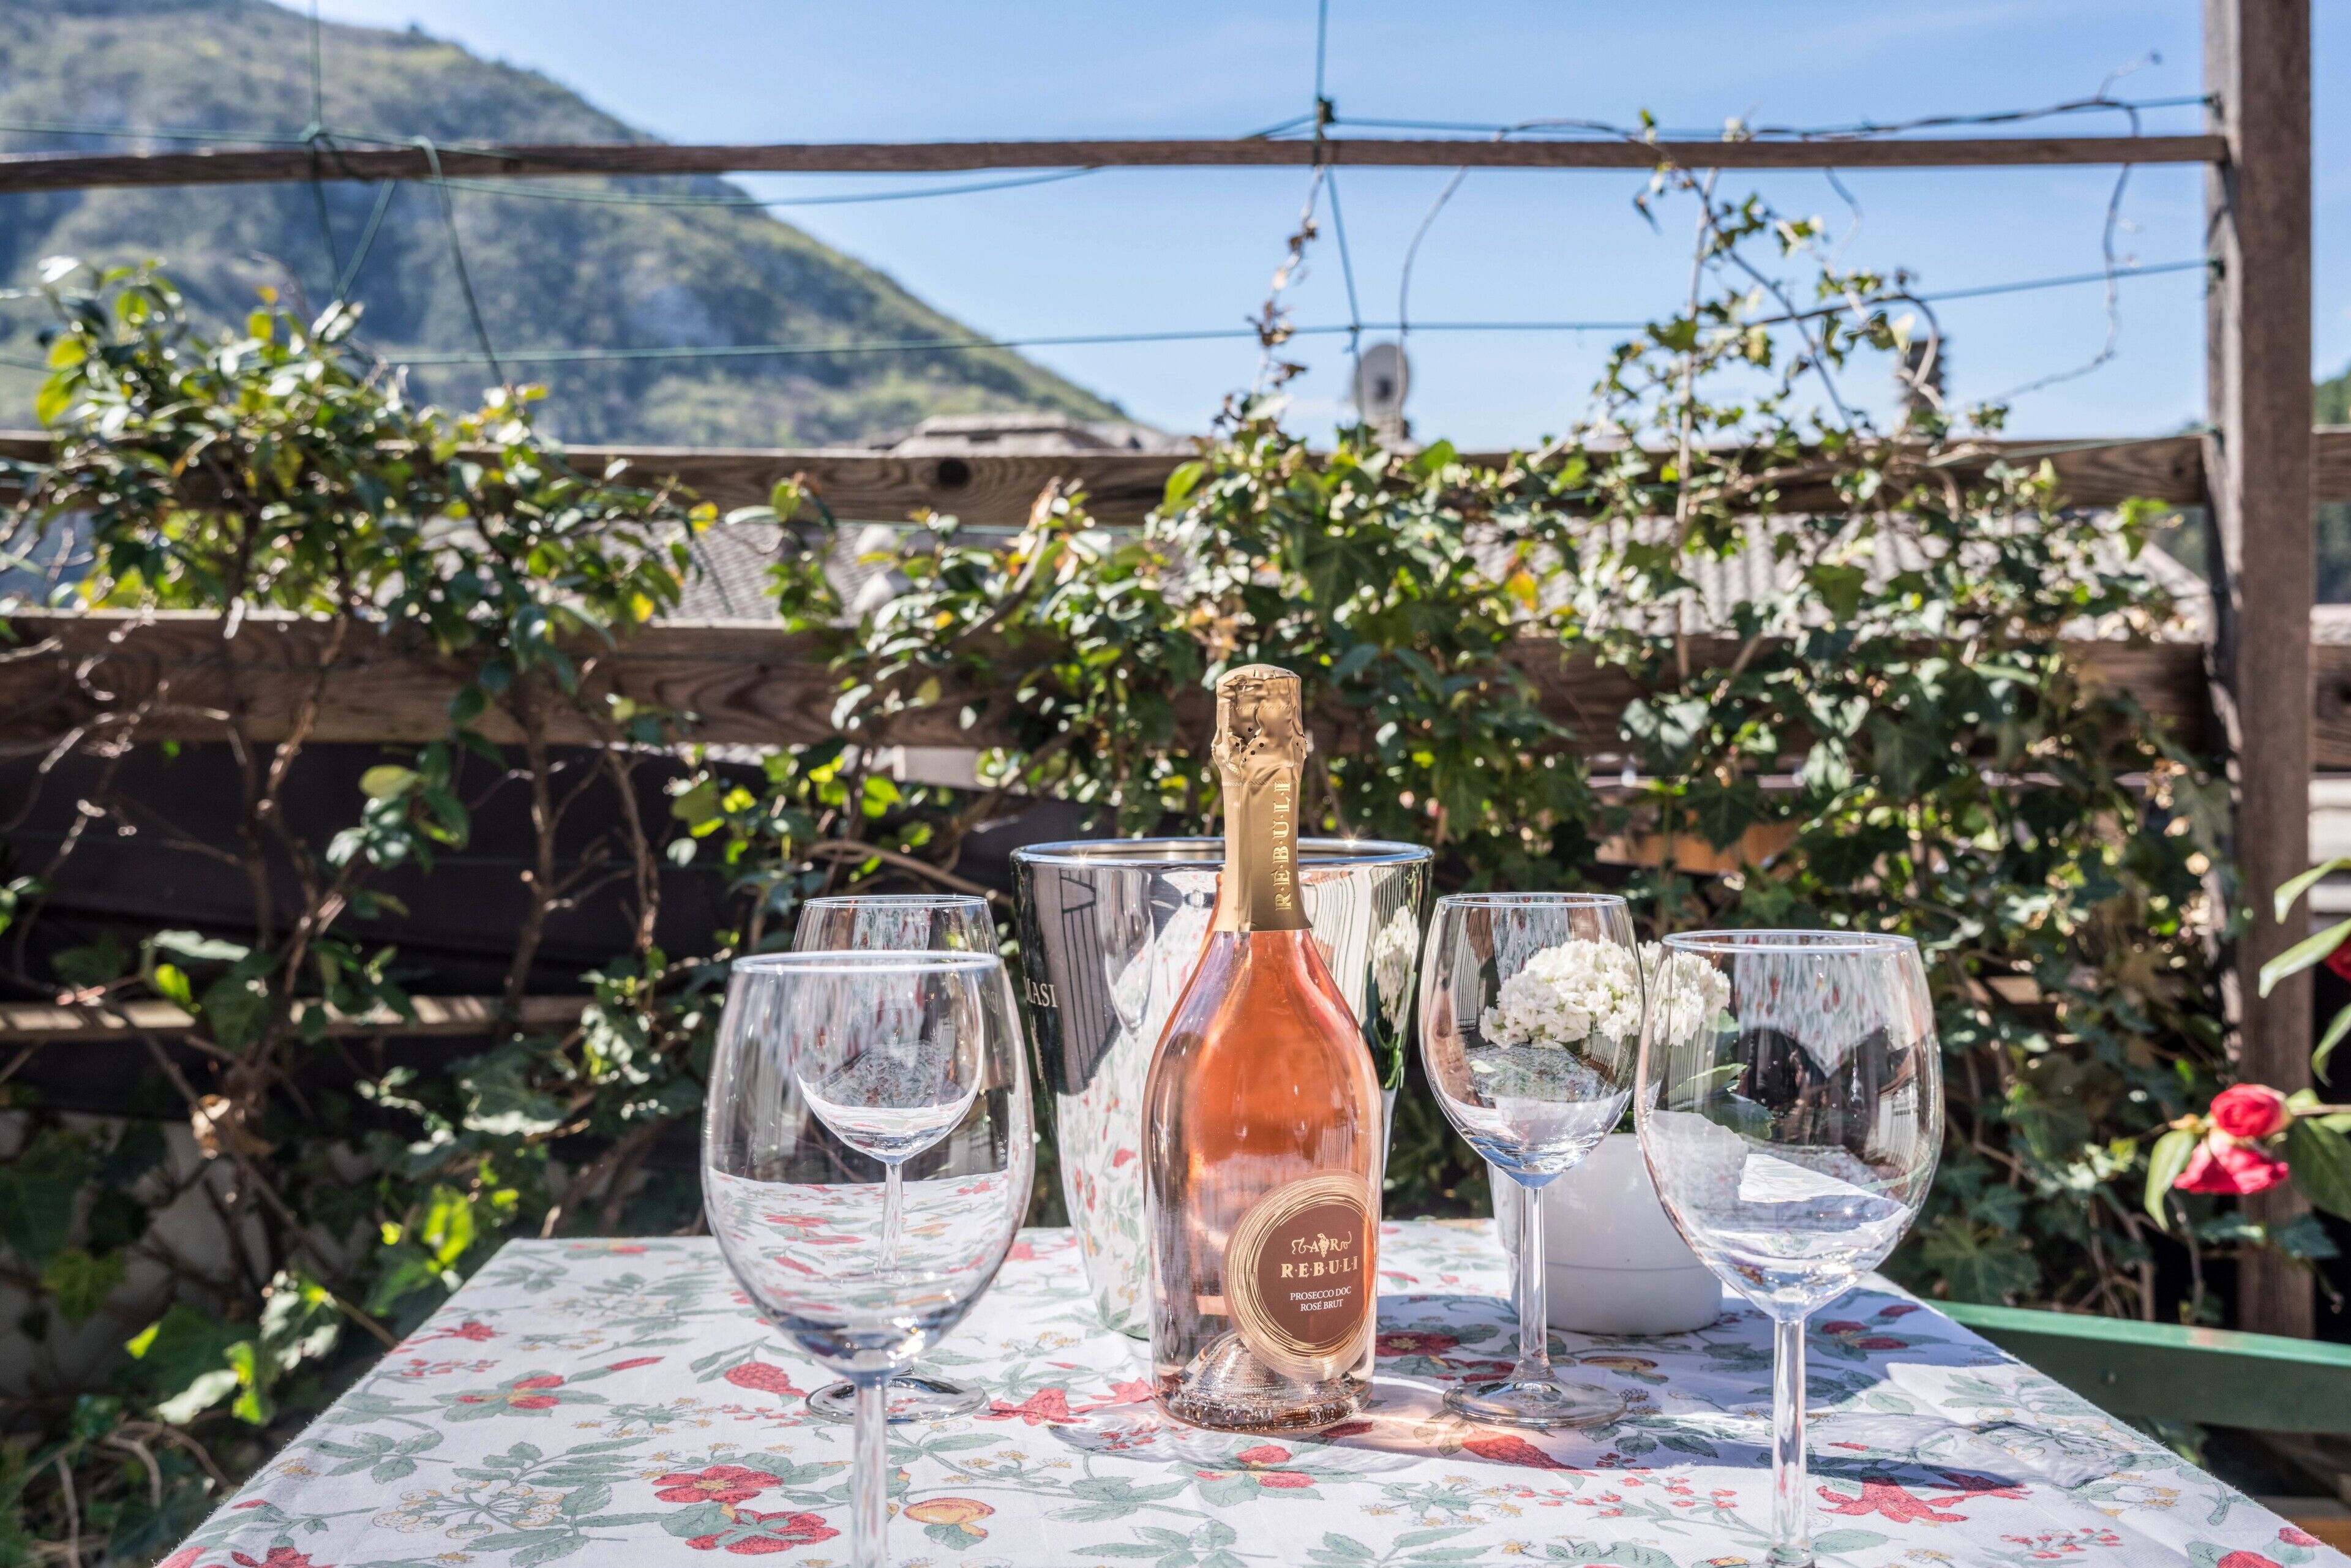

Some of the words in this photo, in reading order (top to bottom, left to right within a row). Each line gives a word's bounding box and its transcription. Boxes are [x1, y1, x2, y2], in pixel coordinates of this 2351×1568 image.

[1290, 1289, 1334, 1300] PROSECCO
[1335, 1286, 1352, 1296] DOC
[1300, 1300, 1322, 1311] ROSÉ
[1323, 1299, 1344, 1310] BRUT
